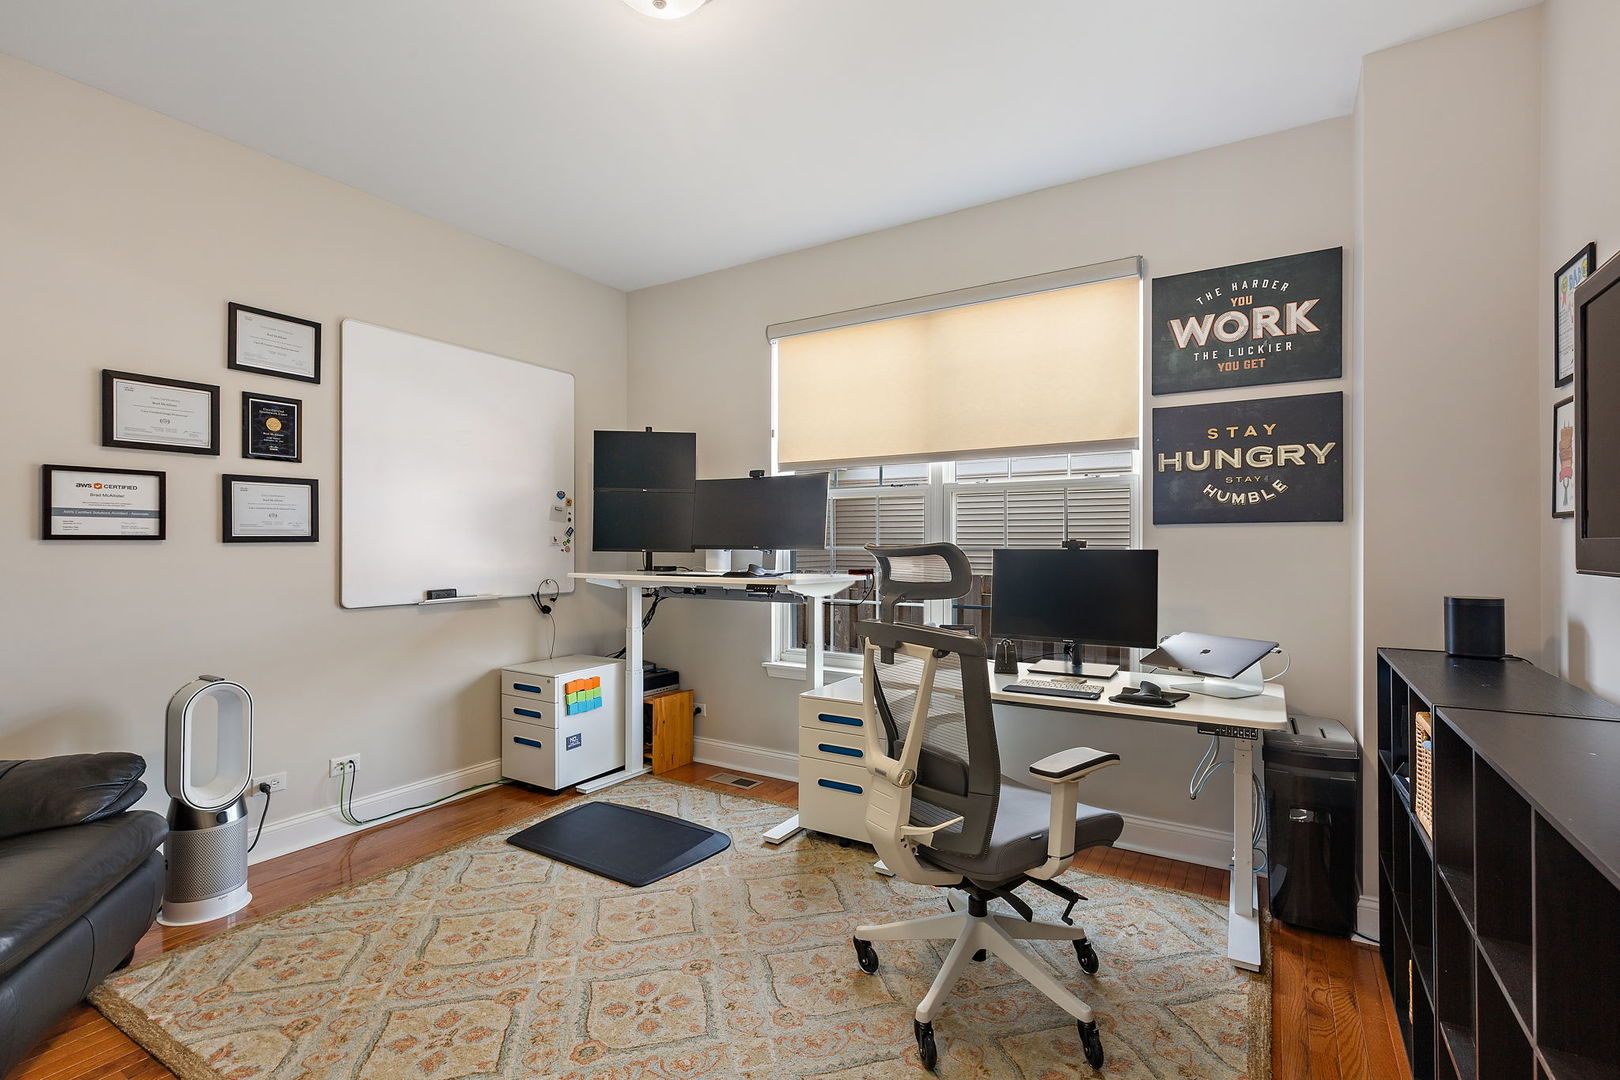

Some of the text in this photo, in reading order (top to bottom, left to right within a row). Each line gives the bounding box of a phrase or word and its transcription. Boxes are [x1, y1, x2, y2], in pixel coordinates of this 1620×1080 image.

[1196, 279, 1289, 305] THE HARDER
[1230, 295, 1253, 307] YOU
[1168, 298, 1321, 349] WORK
[1194, 341, 1292, 361] THE LUCKIER
[1217, 358, 1266, 372] YOU GET
[1207, 423, 1276, 440] STAY
[1157, 442, 1336, 472] HUNGRY
[1225, 475, 1261, 484] STAY
[1202, 479, 1289, 506] HUMBLE
